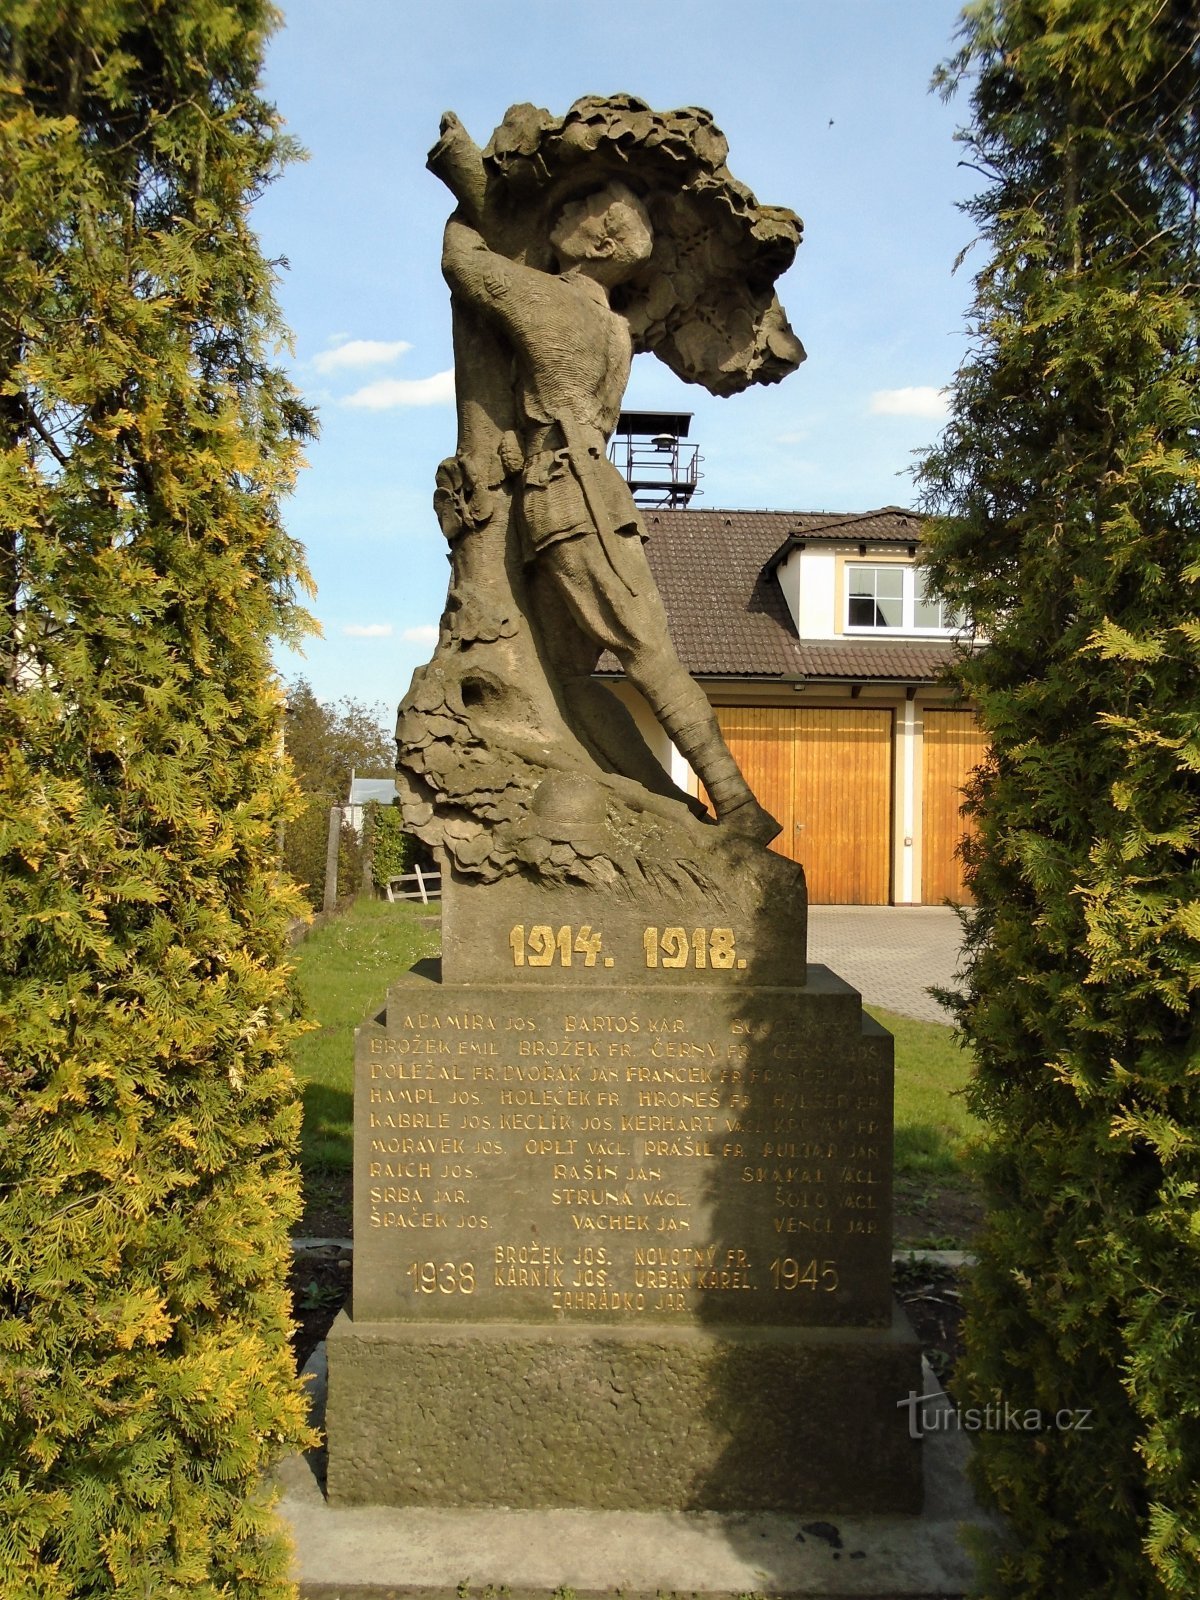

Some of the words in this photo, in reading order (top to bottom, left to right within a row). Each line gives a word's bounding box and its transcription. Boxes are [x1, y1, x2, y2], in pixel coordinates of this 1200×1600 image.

[509, 924, 615, 968] 1914.
[643, 927, 747, 969] 1918.
[565, 1011, 640, 1033] BARTOŠ
[648, 1018, 689, 1033] KAR.
[370, 1034, 451, 1055] BROŽEK
[459, 1041, 499, 1055] EMIL
[519, 1035, 600, 1057] BROŽEK
[608, 1043, 636, 1057] FR.
[651, 1037, 716, 1058] ČERNÝ
[370, 1059, 464, 1080] DOLEŽAL
[472, 1066, 499, 1080] FR.
[503, 1060, 581, 1081] DVOŘÁK
[589, 1067, 619, 1082] JAN
[626, 1066, 713, 1083] FRANCEK
[370, 1088, 440, 1103] HAMPL
[448, 1091, 484, 1105] JOS.
[500, 1086, 591, 1106] HOLEČEK
[597, 1092, 623, 1106] FR.
[639, 1087, 720, 1108] HRONEŠ
[370, 1112, 451, 1128] KABRLE
[460, 1115, 495, 1129] JOS.
[500, 1108, 572, 1130] KECLÍK
[581, 1116, 615, 1131] JOS.
[621, 1114, 717, 1131] KERHART
[370, 1136, 465, 1154] MORÁVEK
[474, 1141, 508, 1155] JOS.
[525, 1139, 578, 1154] OPLT
[587, 1138, 631, 1155] VÁCL.
[644, 1136, 714, 1157] PRÁŠIL
[370, 1162, 431, 1178] RAICH
[440, 1165, 478, 1179] JOS.
[553, 1158, 619, 1180] RAŠÍN
[626, 1166, 662, 1181] JAN
[370, 1187, 423, 1203] SRBA
[433, 1190, 470, 1204] JAR.
[643, 1188, 691, 1206] VÁCL.
[369, 1206, 448, 1228] ŠPAČEK
[457, 1215, 493, 1229] JOS.
[572, 1214, 649, 1230] VACHEK
[657, 1217, 691, 1231] JAN
[494, 1240, 565, 1265] BROŽEK
[572, 1247, 612, 1266] JOS.
[725, 1249, 752, 1268] FR.
[406, 1261, 476, 1295] 1938
[494, 1263, 565, 1287] KÁRNÍK
[572, 1269, 613, 1287] JOS.
[635, 1270, 691, 1289] URBAN
[769, 1257, 839, 1293] 1945
[552, 1289, 646, 1310] ZAHRÁDKO
[654, 1293, 692, 1311] JAR.
